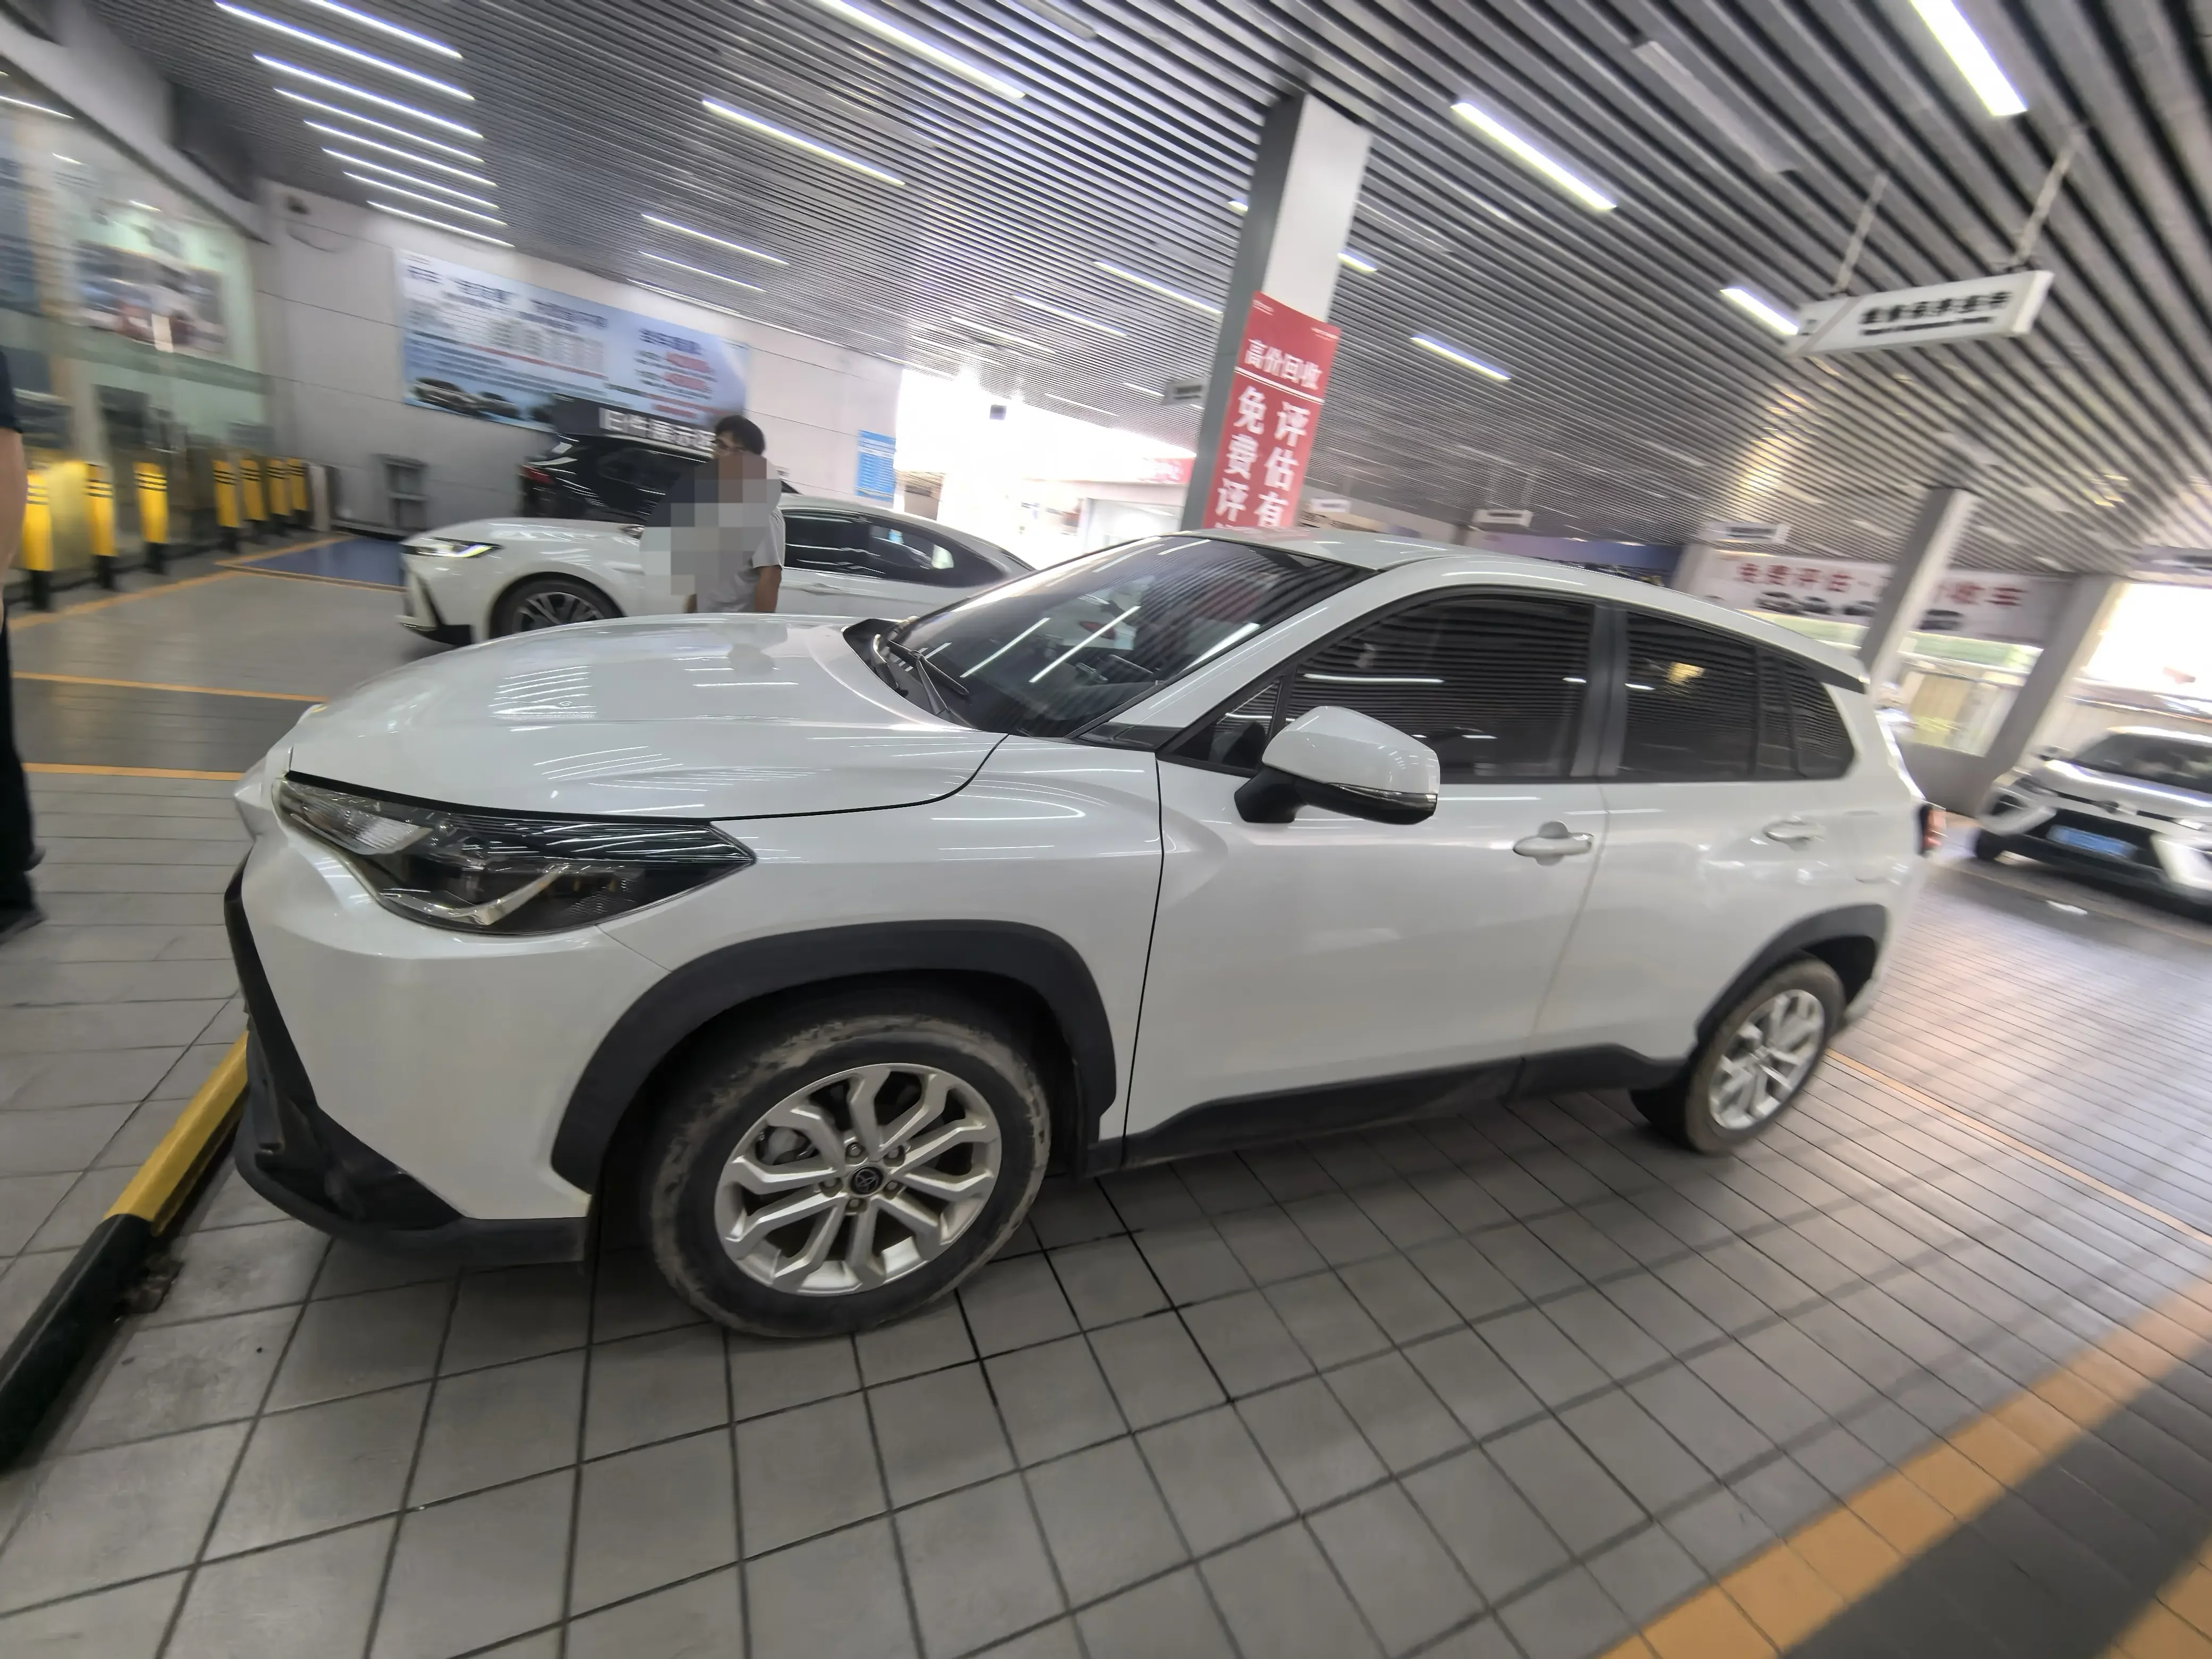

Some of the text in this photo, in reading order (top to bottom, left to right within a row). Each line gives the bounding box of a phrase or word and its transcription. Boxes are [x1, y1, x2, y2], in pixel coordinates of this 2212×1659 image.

[1244, 339, 1323, 390] 高价回收
[1214, 386, 1268, 529] 免费评
[1254, 401, 1311, 527] 评估有
